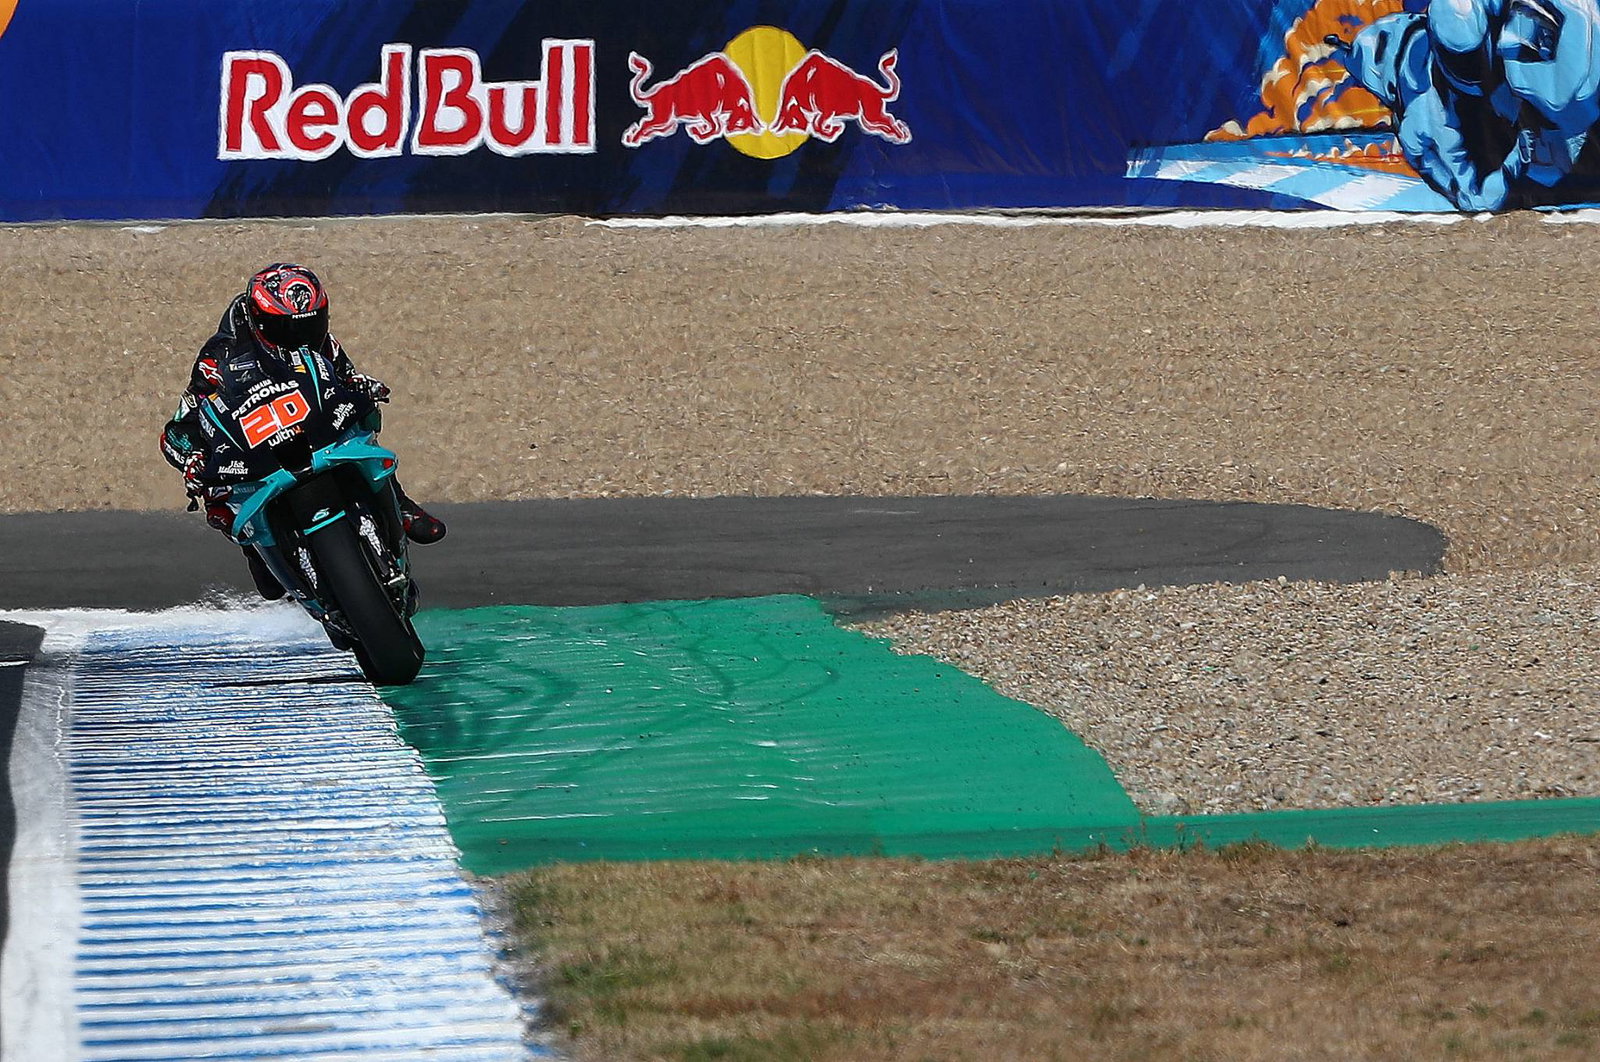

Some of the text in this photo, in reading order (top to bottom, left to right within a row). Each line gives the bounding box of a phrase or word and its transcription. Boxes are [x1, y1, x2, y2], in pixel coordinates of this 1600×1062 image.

[221, 42, 594, 157] Red Bull
[231, 380, 300, 420] PETRONAS
[239, 389, 311, 450] 20
